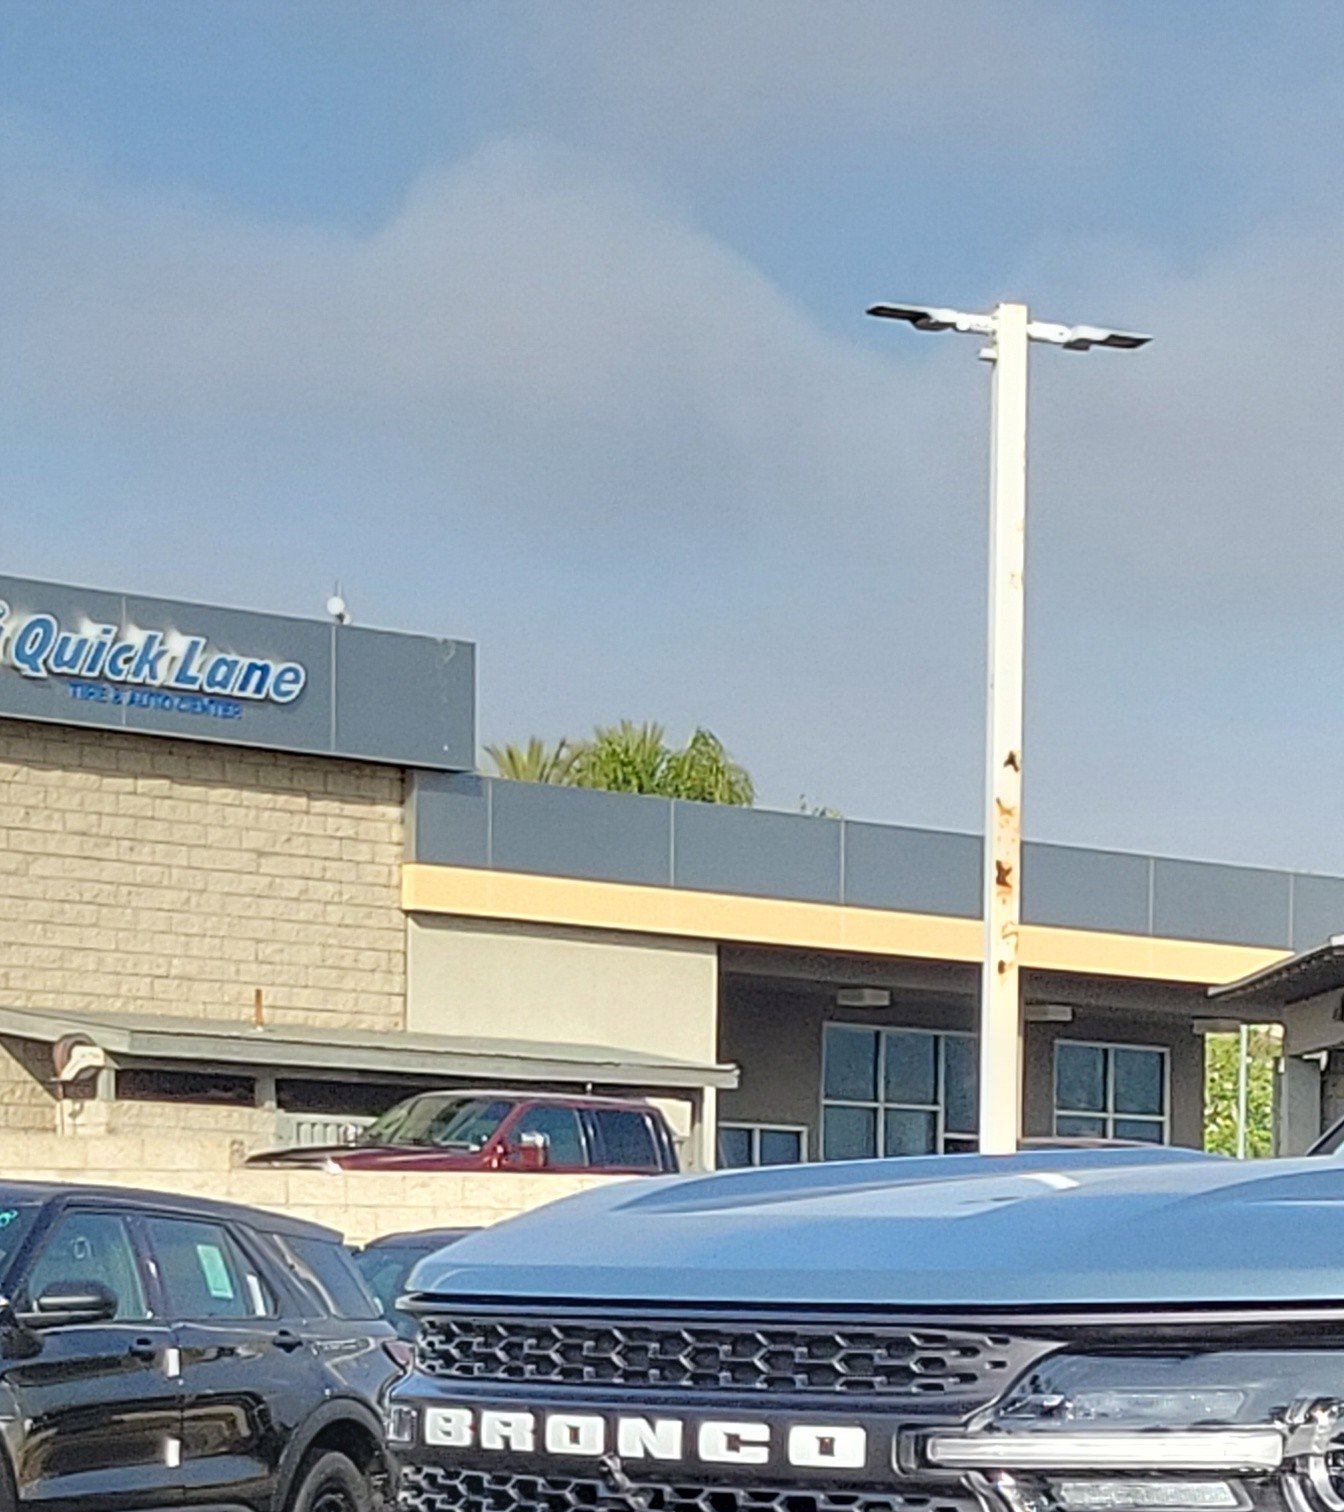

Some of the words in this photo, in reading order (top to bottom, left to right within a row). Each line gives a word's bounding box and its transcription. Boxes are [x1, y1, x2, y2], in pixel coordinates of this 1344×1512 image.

[12, 612, 165, 680] Quick
[170, 635, 305, 701] Lane
[424, 1405, 868, 1469] BRONCO
